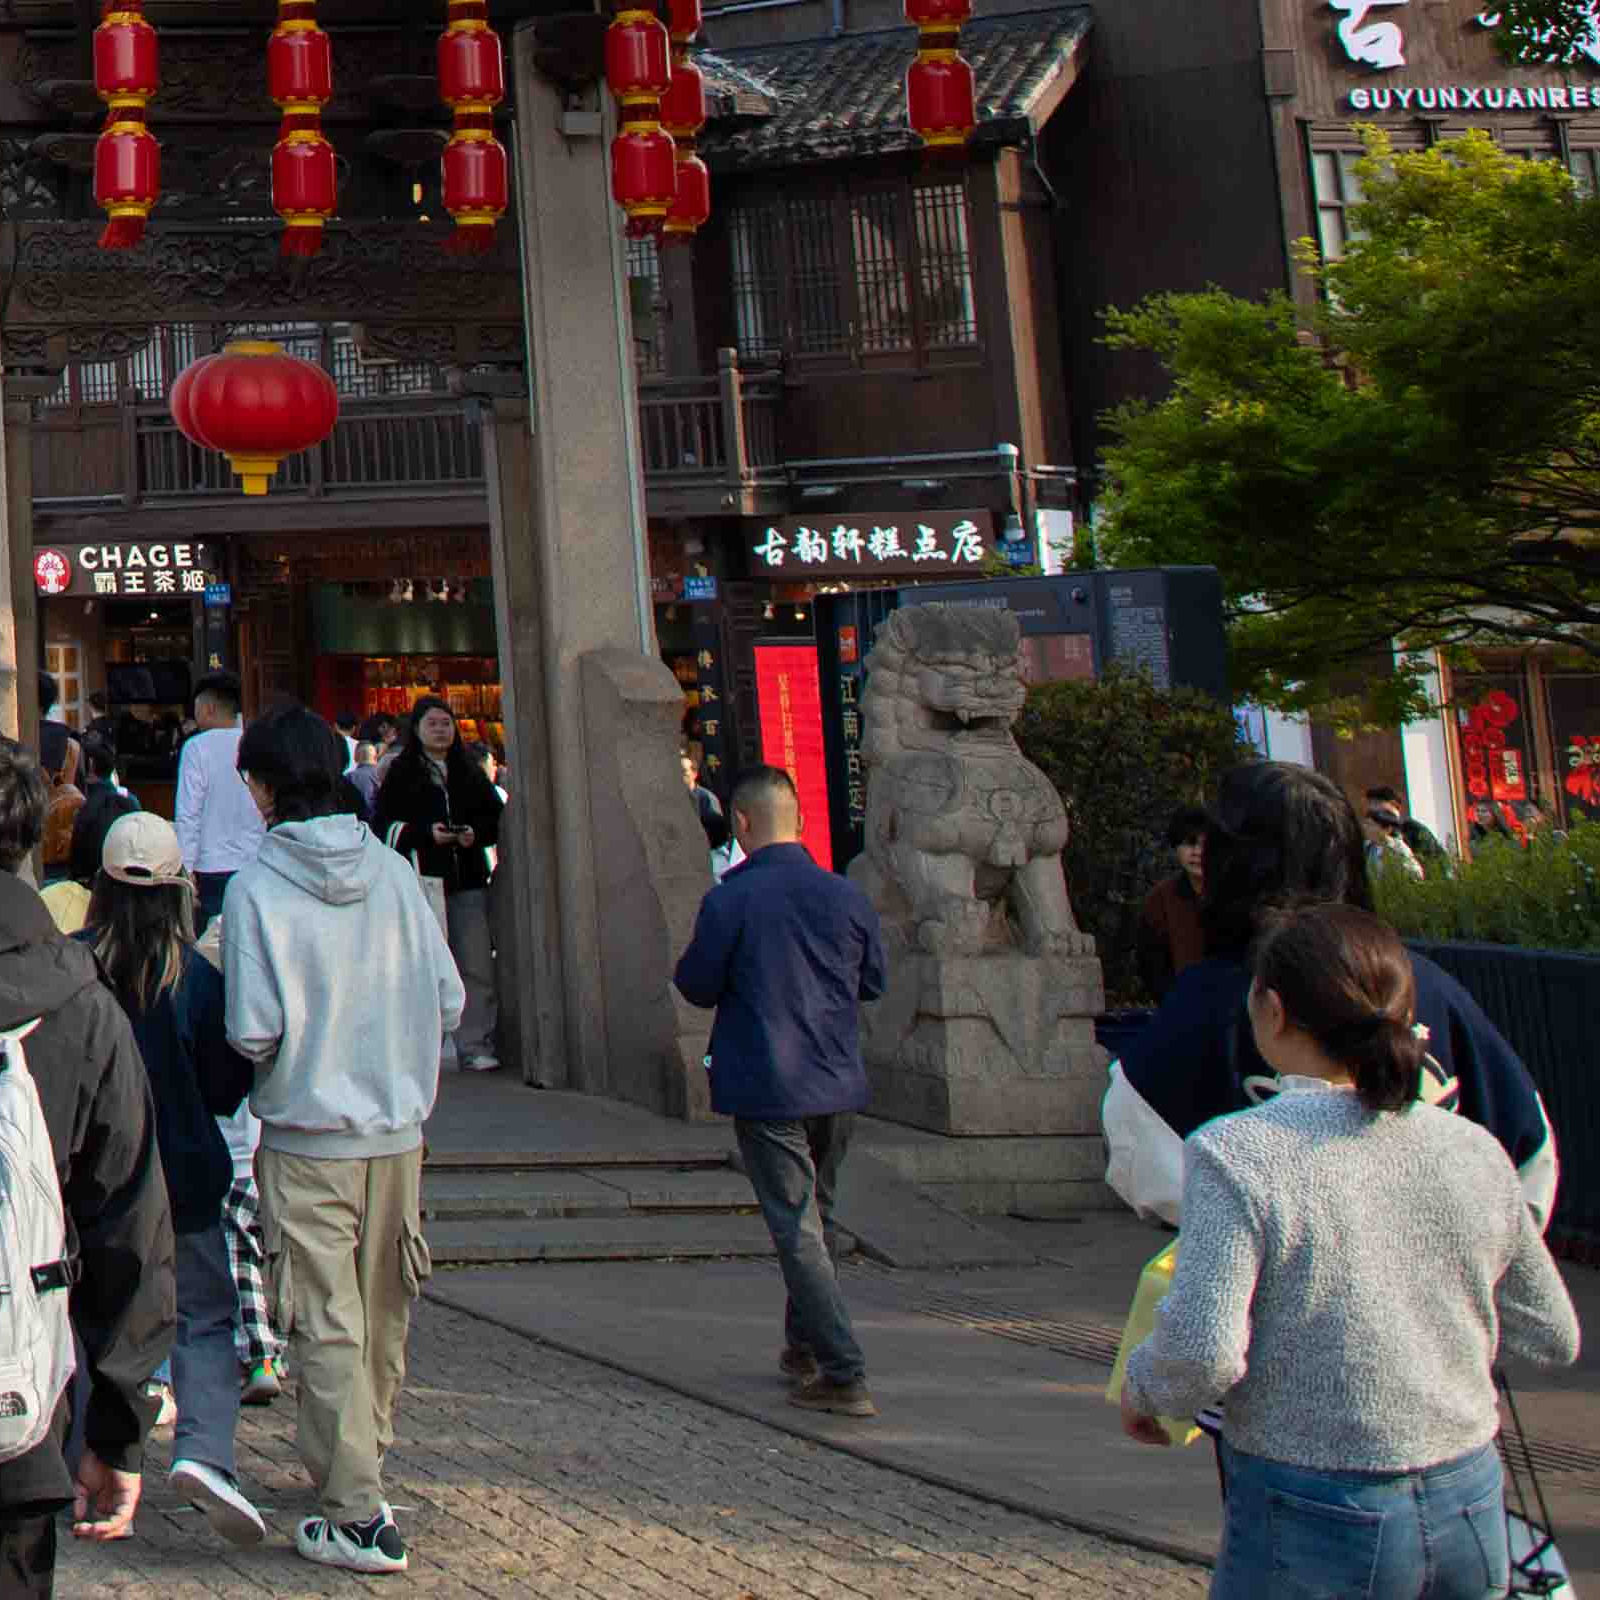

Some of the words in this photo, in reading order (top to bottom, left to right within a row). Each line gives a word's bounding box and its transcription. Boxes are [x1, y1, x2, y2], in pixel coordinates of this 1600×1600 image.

[753, 520, 985, 565] 古韵轩糕点店
[78, 543, 204, 569] CHAGE
[93, 569, 206, 594] 霸王茶姬
